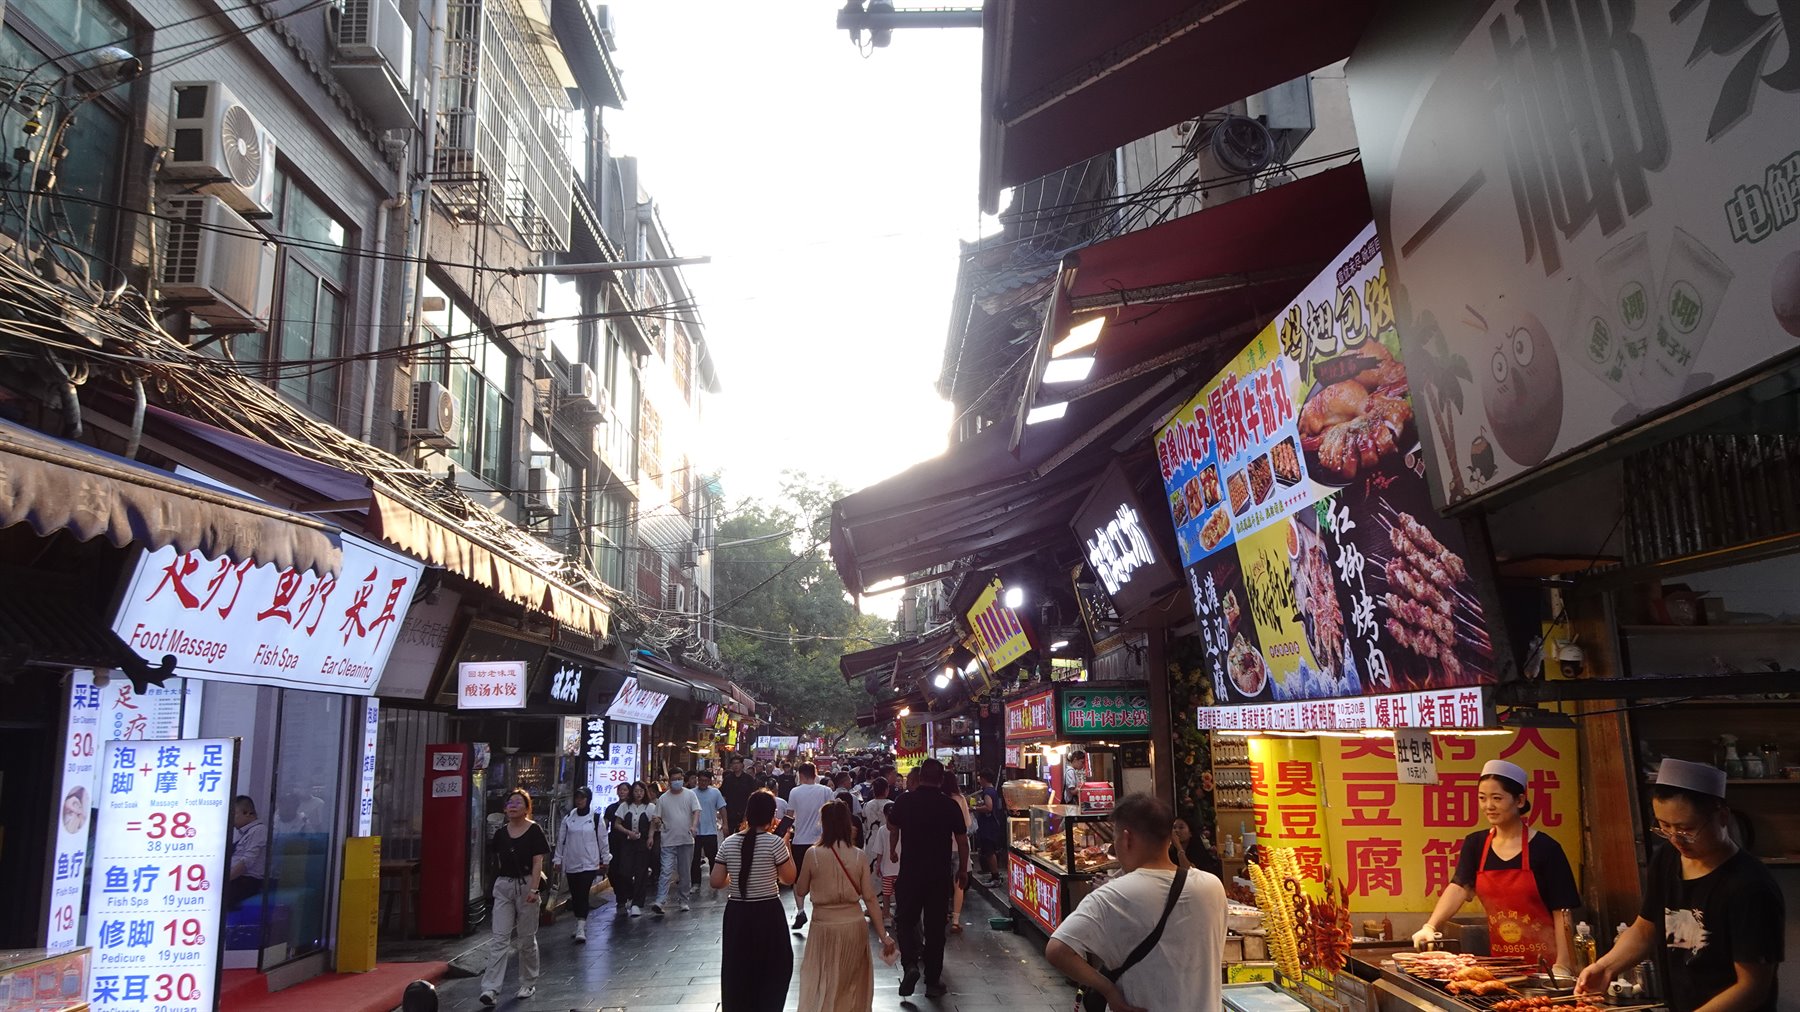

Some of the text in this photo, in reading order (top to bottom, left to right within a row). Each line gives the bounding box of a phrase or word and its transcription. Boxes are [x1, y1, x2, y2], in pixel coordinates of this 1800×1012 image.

[1281, 267, 1396, 365] 鸡翅包饭
[1207, 361, 1293, 463] 爆辣牛筋丸
[1327, 499, 1391, 690] 红柳烤肉
[339, 566, 407, 655] 采耳
[130, 623, 227, 663] Foot Massage
[1190, 568, 1229, 702] 臭豆腐
[253, 643, 299, 669] Fish Spa
[321, 656, 373, 683] Ear Cleaning
[73, 684, 100, 710] 采耳
[465, 683, 517, 696] 酸汤水饺
[112, 684, 147, 740] 足疗
[1069, 710, 1149, 728] 腊牛肉夹馍
[1302, 702, 1365, 729] 铁板鸭肠 10元30串
[1375, 698, 1408, 728] 爆肚
[1418, 692, 1479, 728] 烤面筋
[435, 756, 459, 767] 冷饮
[1397, 738, 1434, 764] 肚包肉
[110, 746, 136, 795] 泡脚
[154, 745, 181, 793] 按摩
[199, 744, 222, 792] 足疗
[110, 798, 223, 809] Foot Soak Massage Foot Massage
[1276, 760, 1324, 883] 臭豆腐
[147, 841, 194, 853] 38 yuan
[56, 850, 84, 880] 鱼疗
[103, 865, 160, 893] 鱼疗
[107, 895, 204, 908] Fish Spa 19 yuan
[99, 919, 154, 949] 修脚
[101, 951, 200, 963] Pedicure 19 yuan
[93, 974, 149, 1004] 采耳
